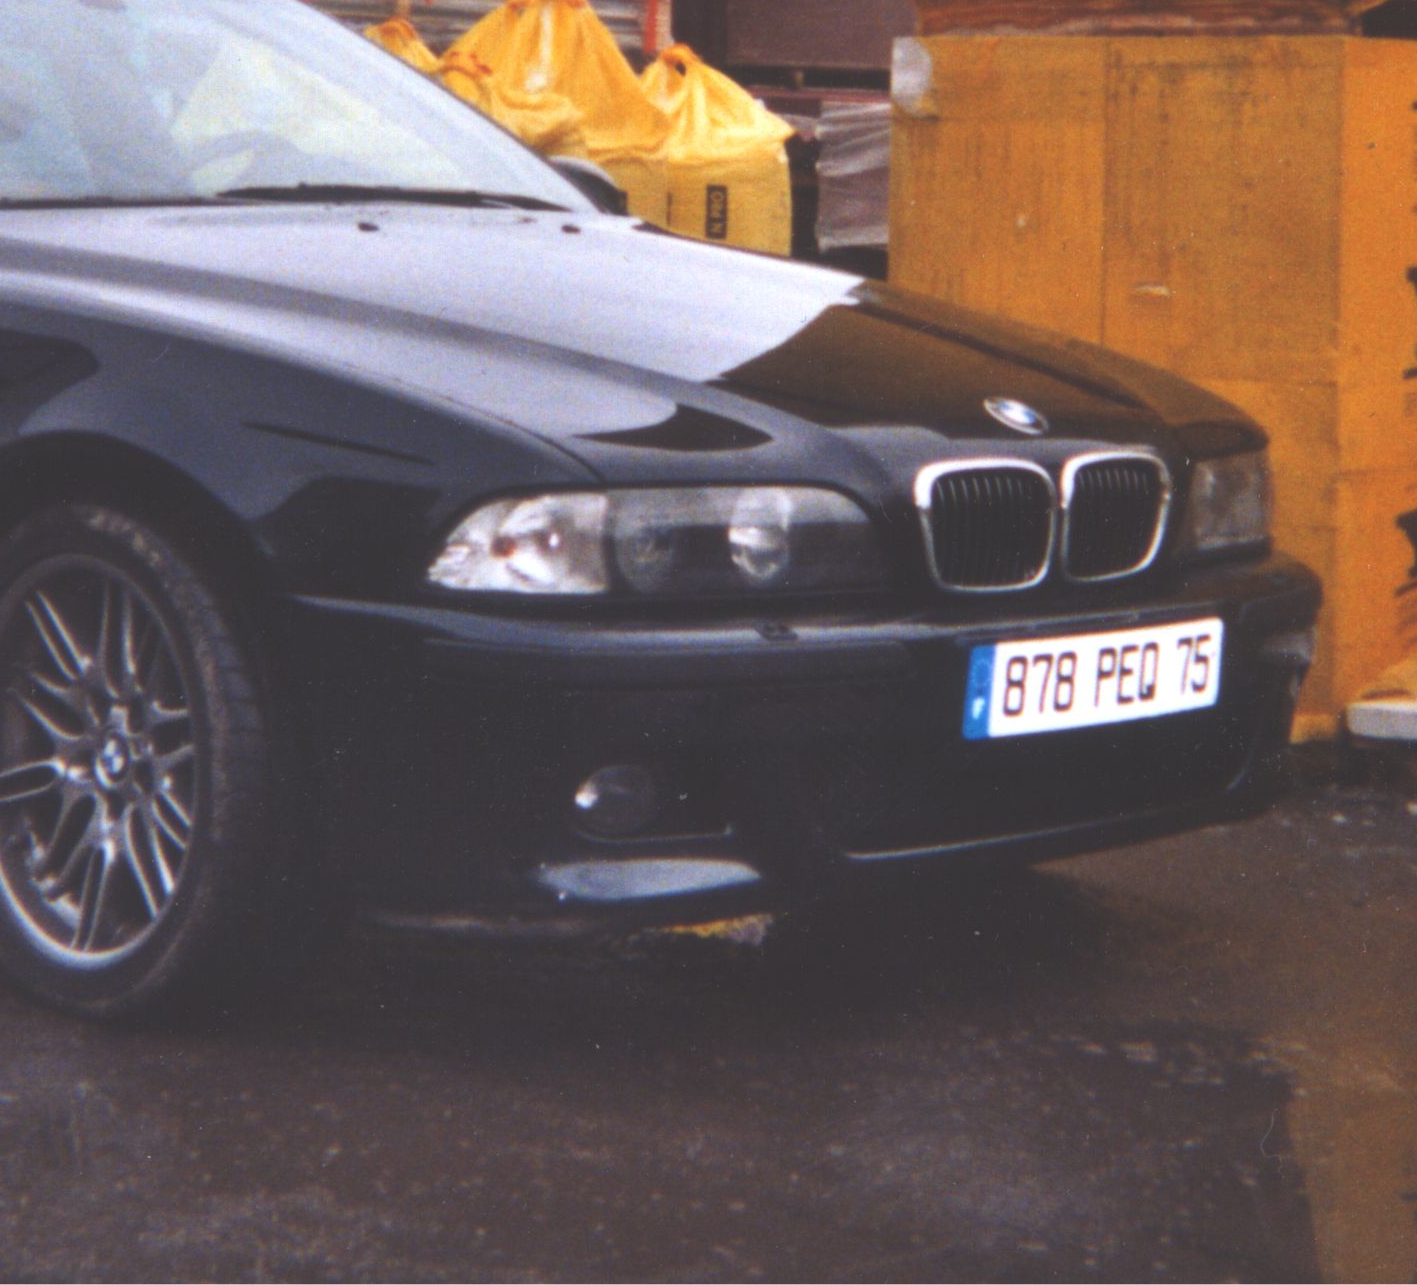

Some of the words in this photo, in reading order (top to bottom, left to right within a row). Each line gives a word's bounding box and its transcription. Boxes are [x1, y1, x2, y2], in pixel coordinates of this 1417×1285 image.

[1002, 651, 1078, 718] 878
[1094, 641, 1160, 708] PEQ
[1177, 633, 1211, 695] 75
